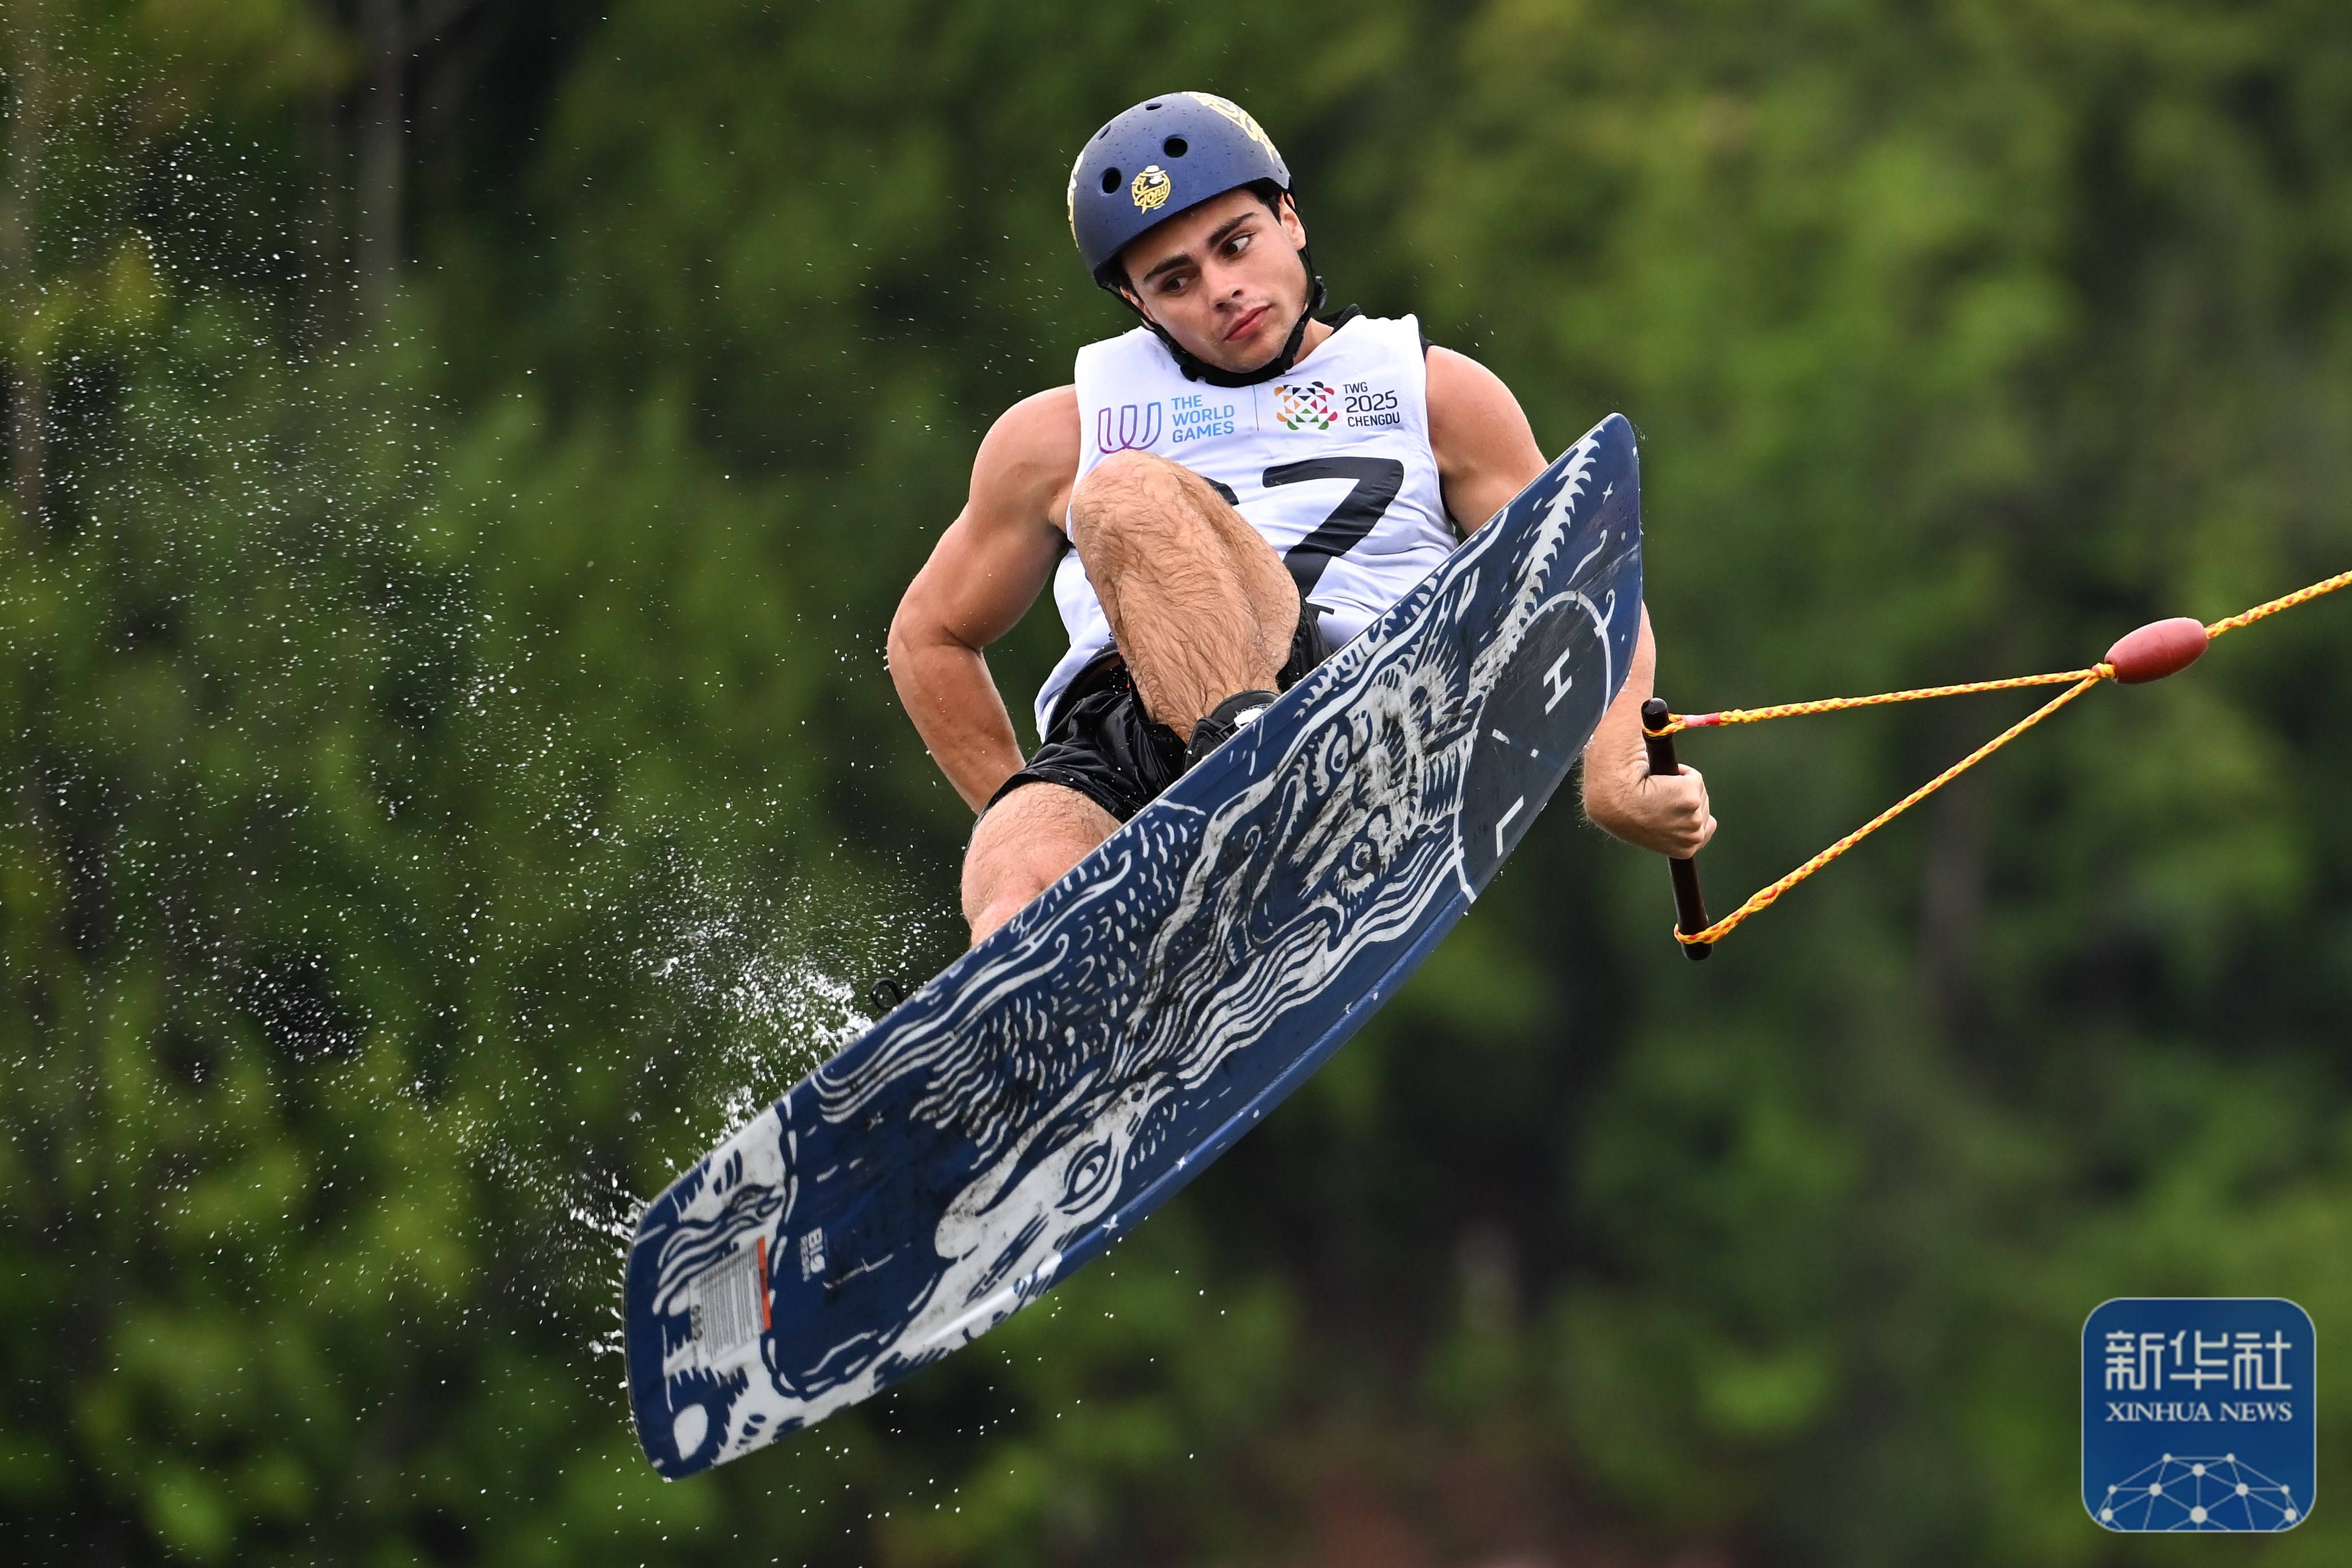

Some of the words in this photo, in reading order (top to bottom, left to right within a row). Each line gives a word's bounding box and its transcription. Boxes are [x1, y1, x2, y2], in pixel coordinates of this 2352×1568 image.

[1343, 382, 1368, 393] TWG
[1171, 394, 1202, 411] THE
[1345, 390, 1398, 413] 2025
[1172, 405, 1235, 427] WORLD
[1347, 411, 1401, 427] CHENGDU
[1172, 421, 1235, 443] GAMES
